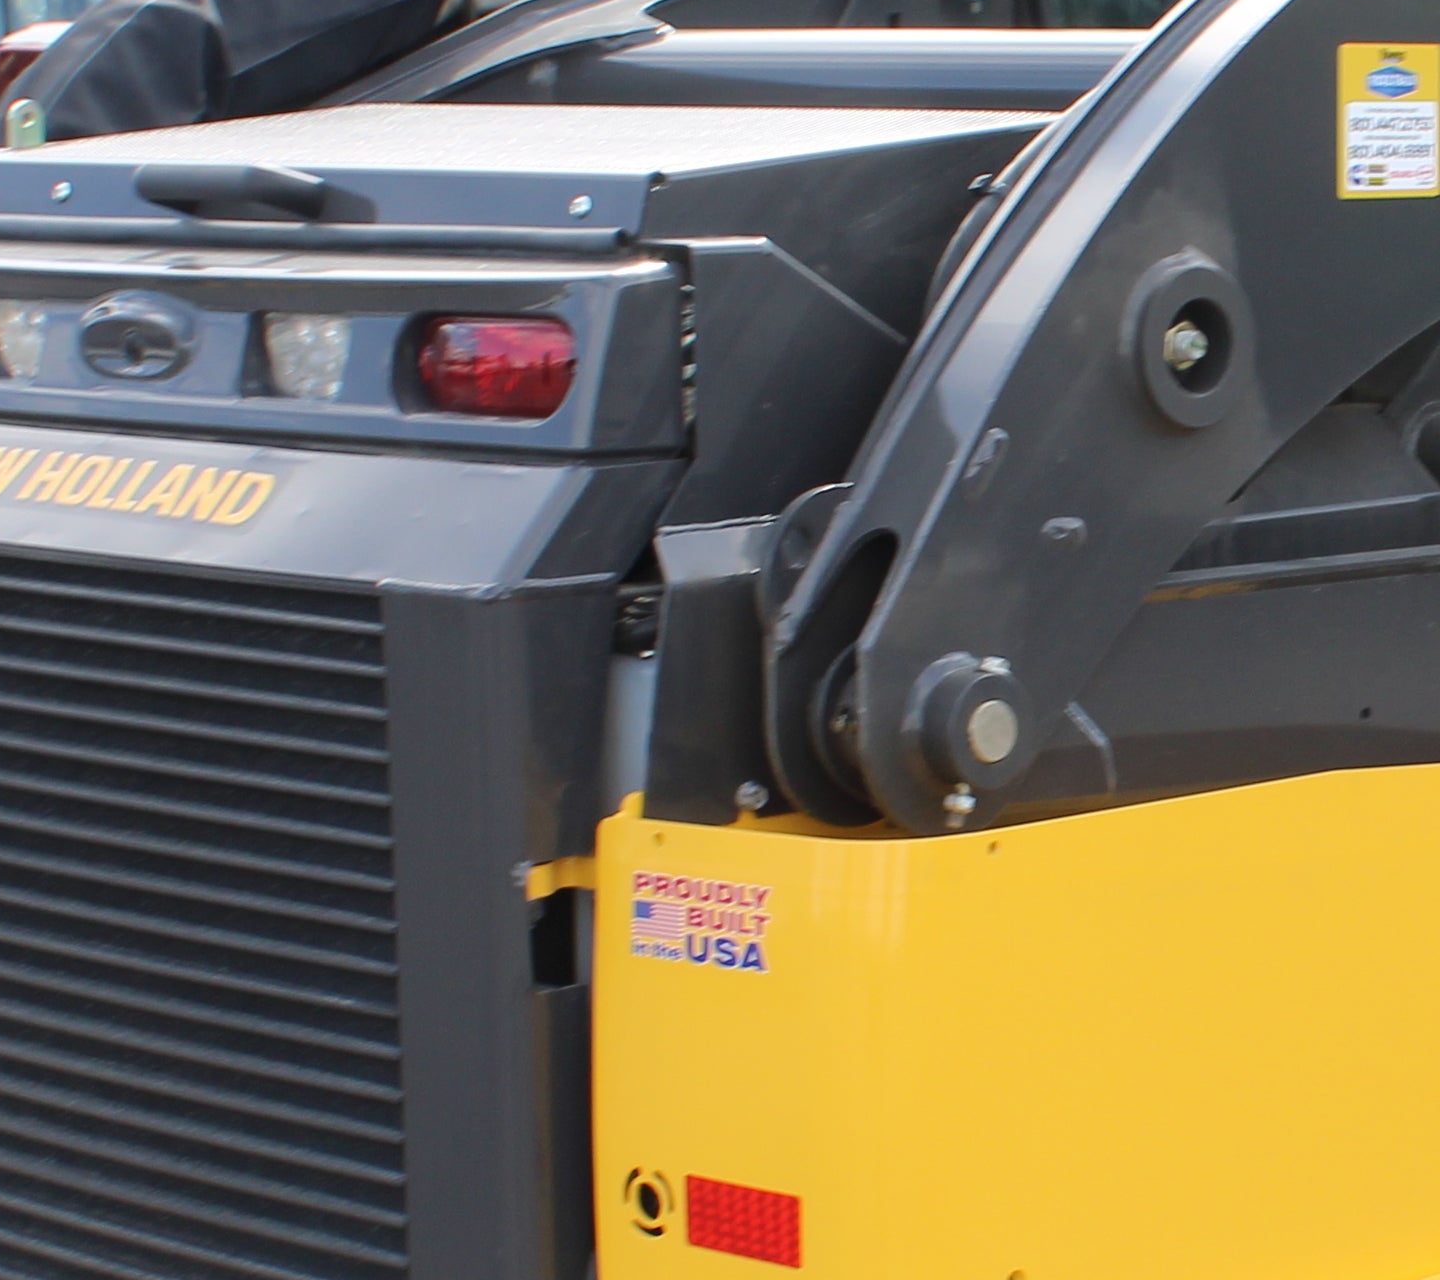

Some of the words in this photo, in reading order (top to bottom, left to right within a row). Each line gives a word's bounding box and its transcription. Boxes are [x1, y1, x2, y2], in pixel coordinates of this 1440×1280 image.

[15, 450, 276, 527] HOLLAND
[633, 871, 772, 909] PROUDLY
[686, 904, 771, 938] BUILT
[686, 933, 768, 972] USA
